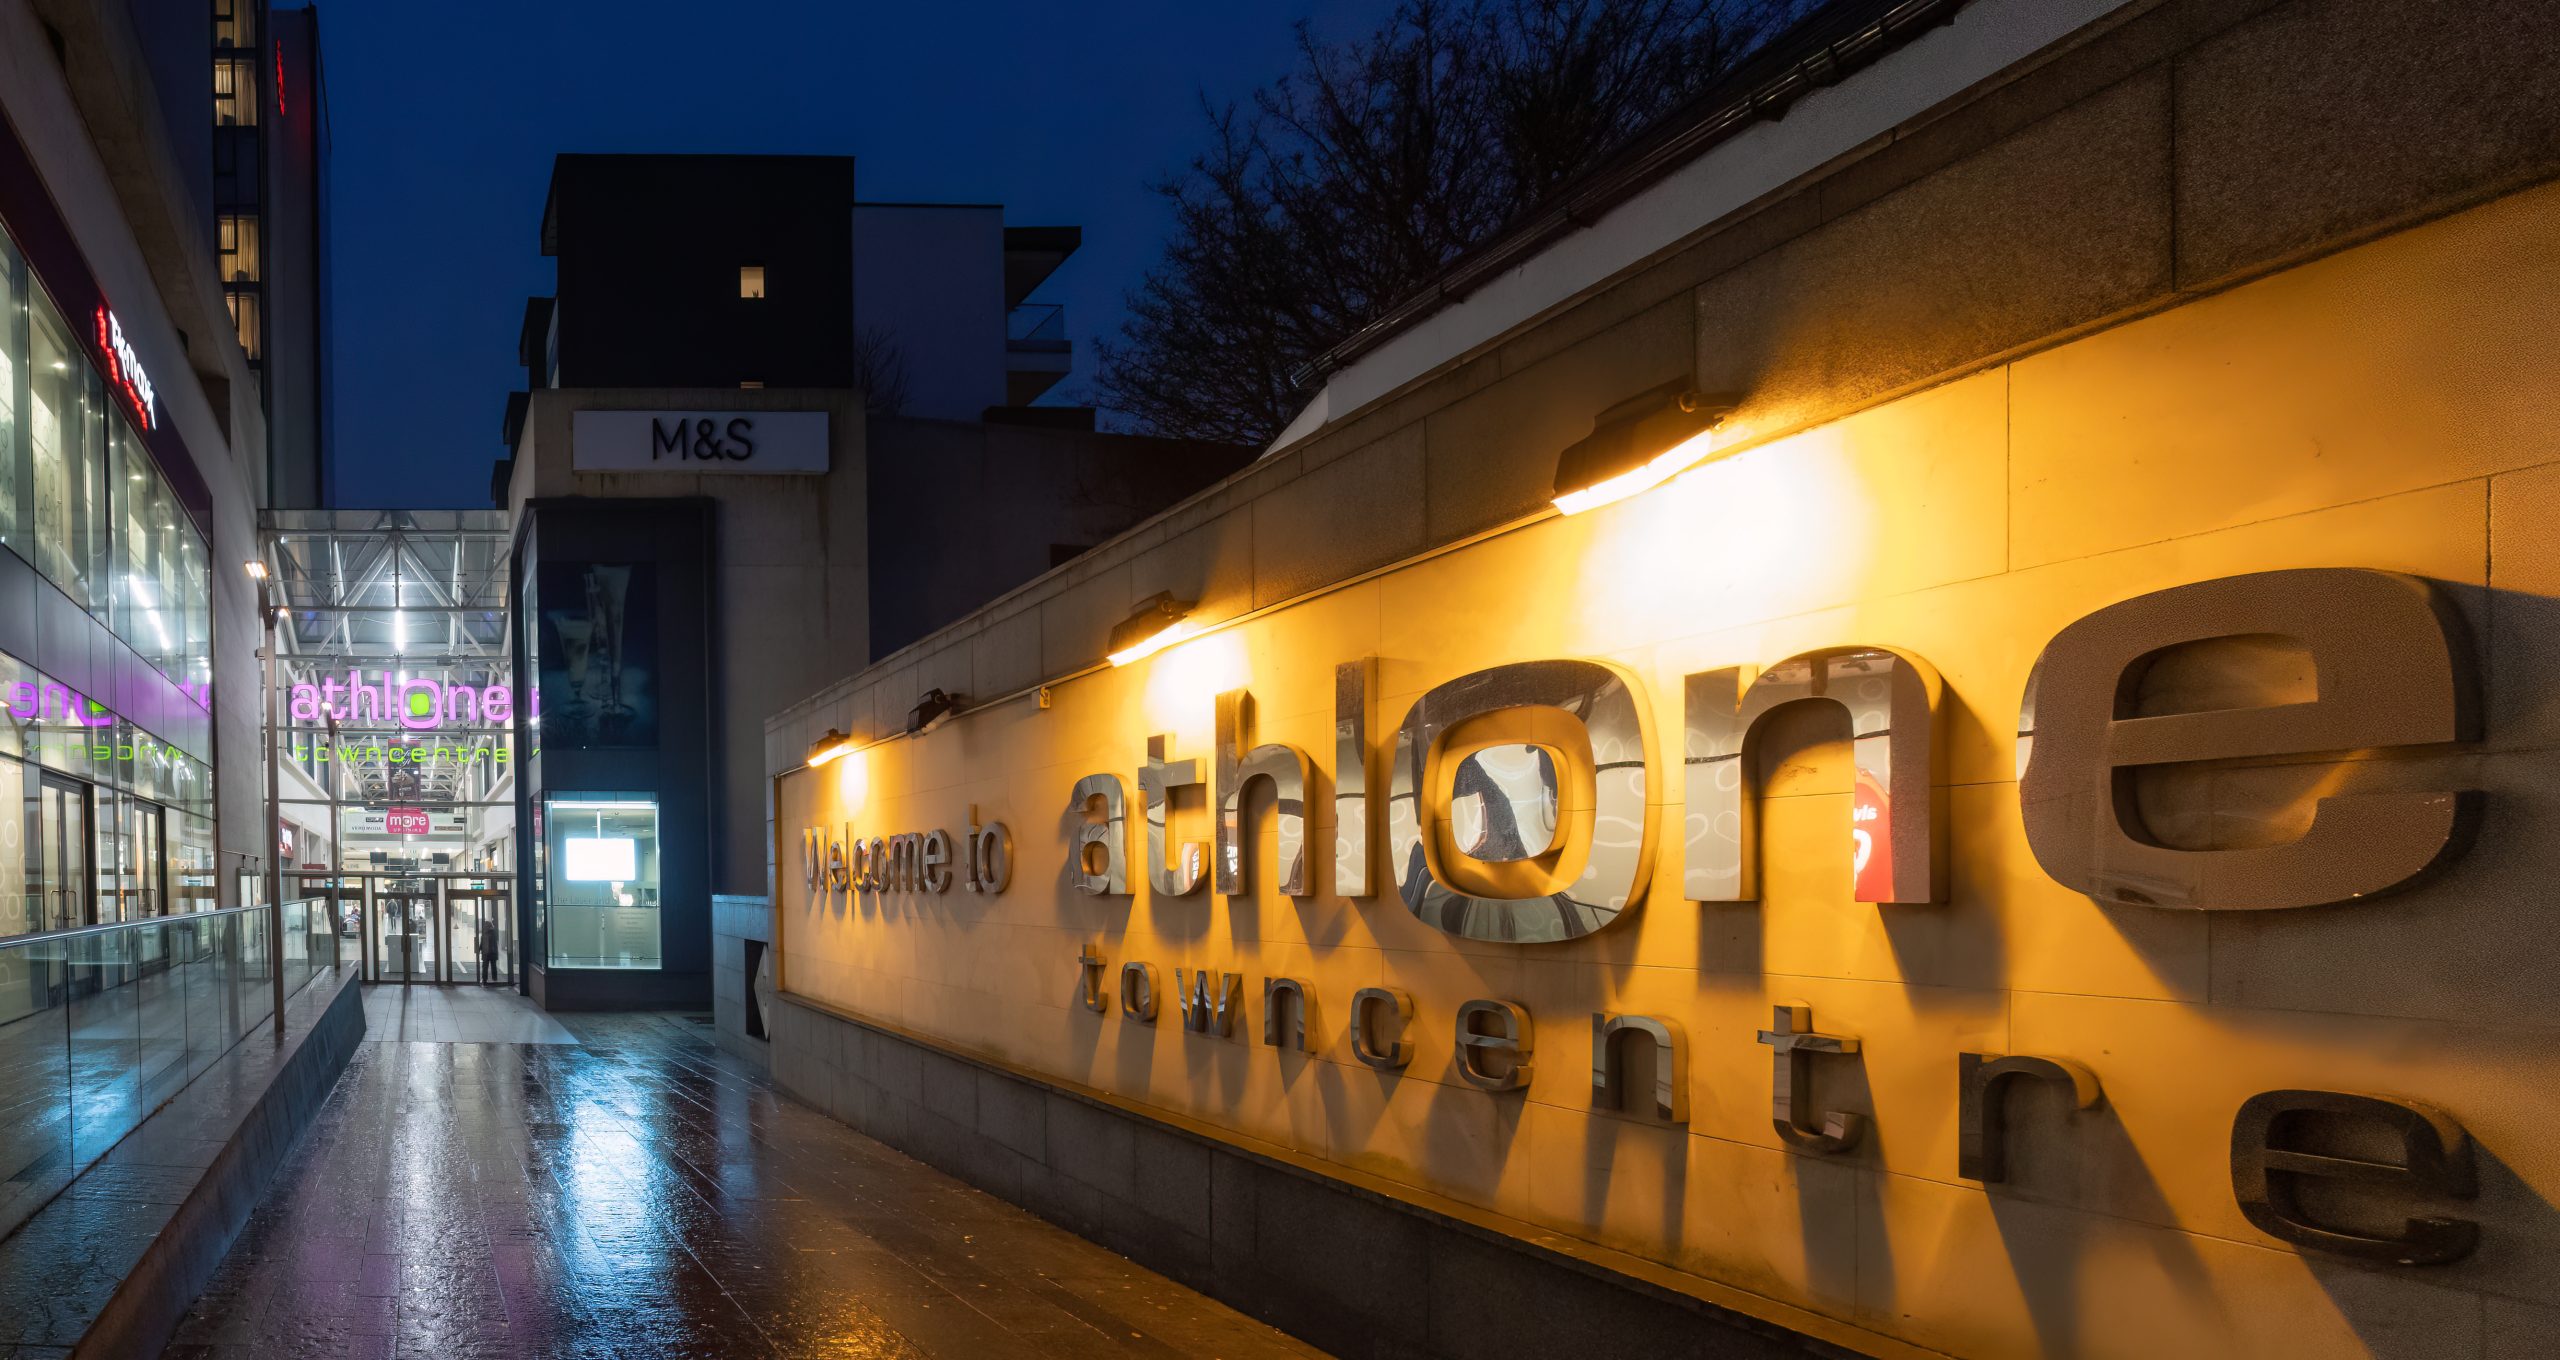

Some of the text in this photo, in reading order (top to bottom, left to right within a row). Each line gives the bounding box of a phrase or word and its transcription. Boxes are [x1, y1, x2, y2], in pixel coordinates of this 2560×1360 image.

[651, 416, 755, 462] M&S
[1069, 567, 2480, 944] athlone
[389, 815, 427, 828] more
[803, 803, 1013, 894] Welcome to
[1078, 942, 2478, 1265] towncentre
